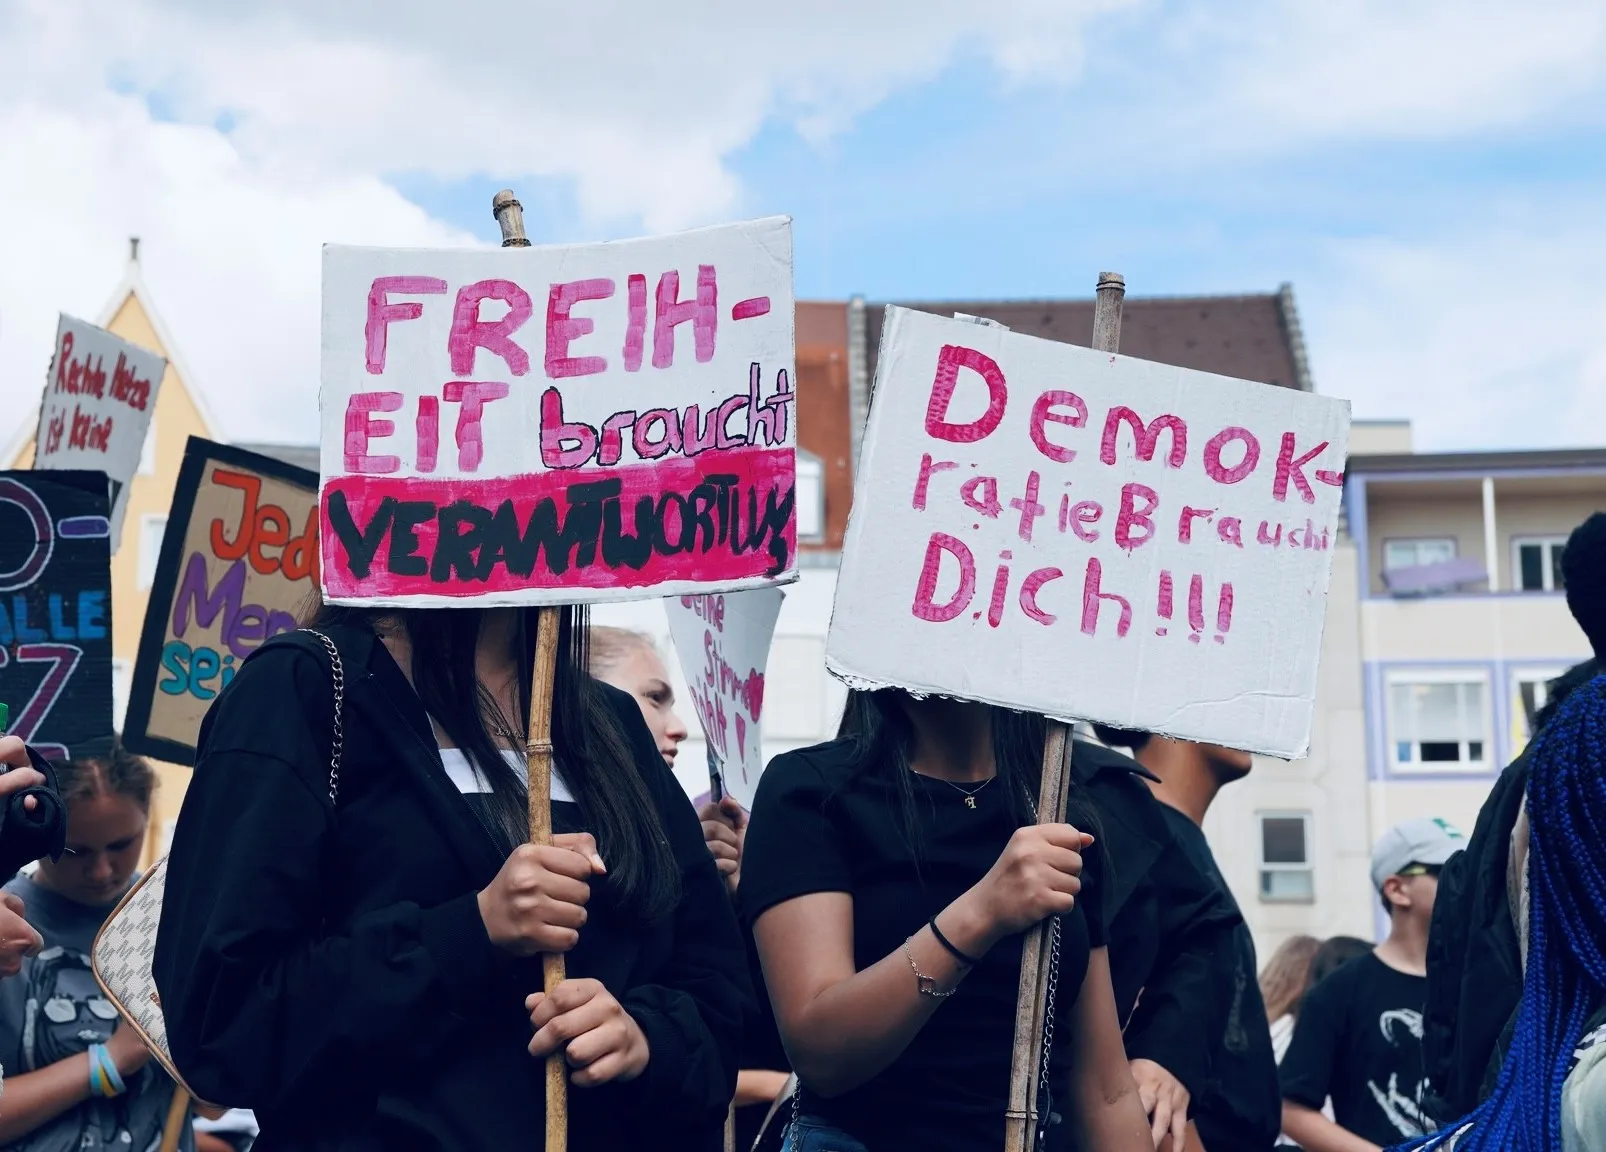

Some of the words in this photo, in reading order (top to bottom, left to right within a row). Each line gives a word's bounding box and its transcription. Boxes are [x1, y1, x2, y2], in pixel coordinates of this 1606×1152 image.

[365, 264, 771, 378] FREIH-
[343, 381, 510, 473] EIT
[538, 362, 795, 470] braucht
[925, 344, 1344, 504] Demok-
[911, 531, 1235, 645] Dich!!!
